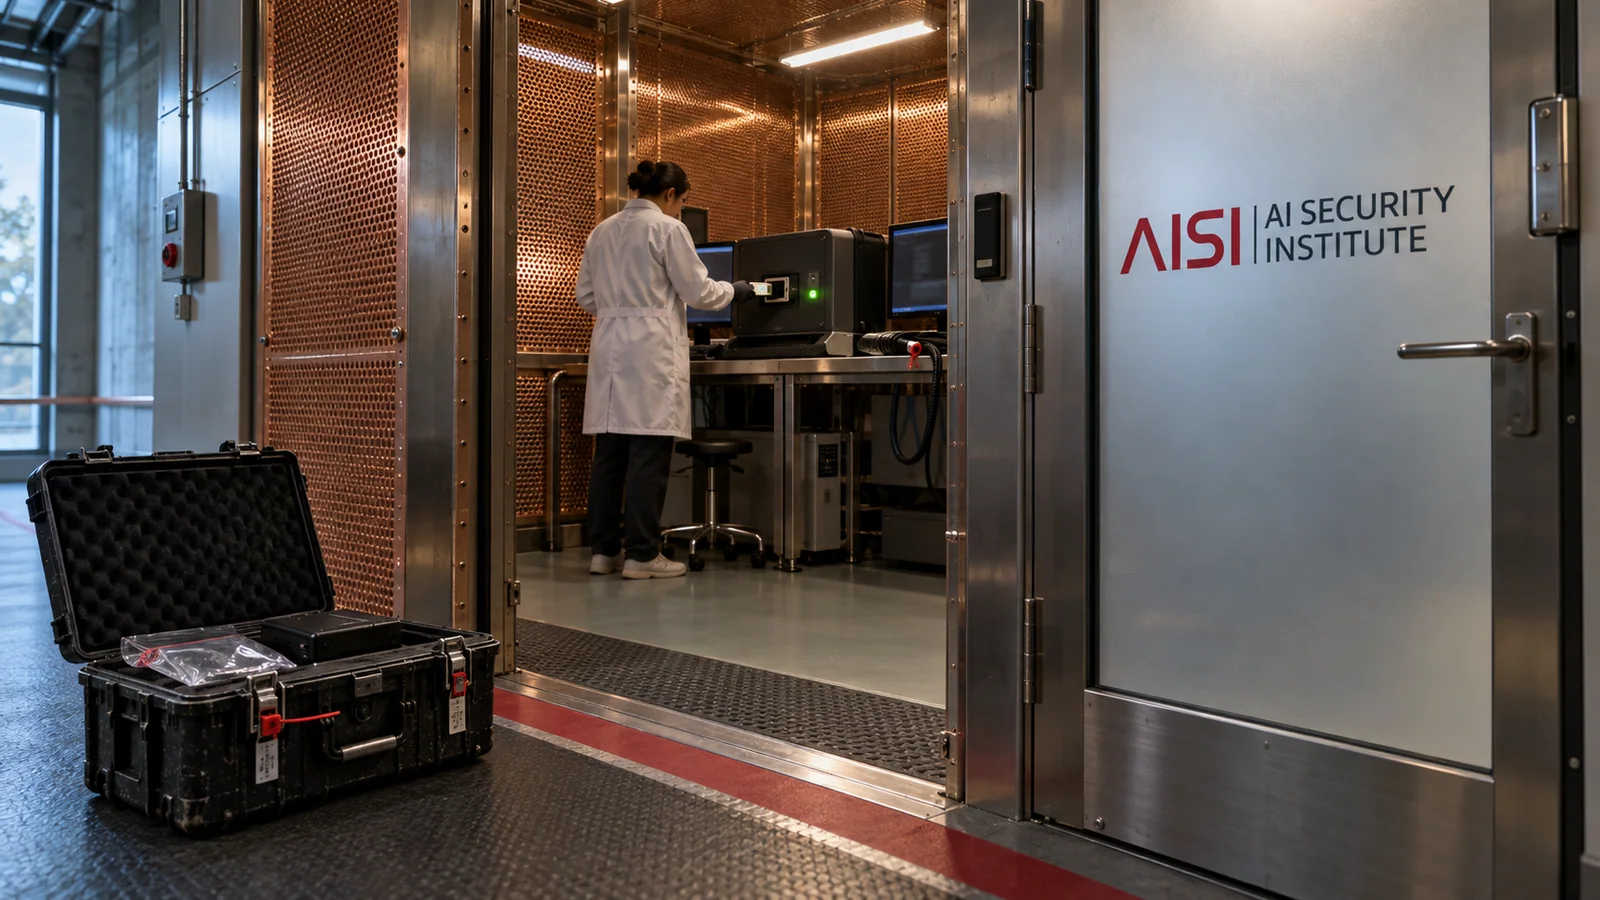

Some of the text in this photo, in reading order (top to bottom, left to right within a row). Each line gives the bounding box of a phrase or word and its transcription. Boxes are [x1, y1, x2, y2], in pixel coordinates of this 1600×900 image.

[1263, 184, 1456, 230] AI SECURITY
[1120, 206, 1241, 275] AISI
[1265, 224, 1428, 264] INSTITUTE
